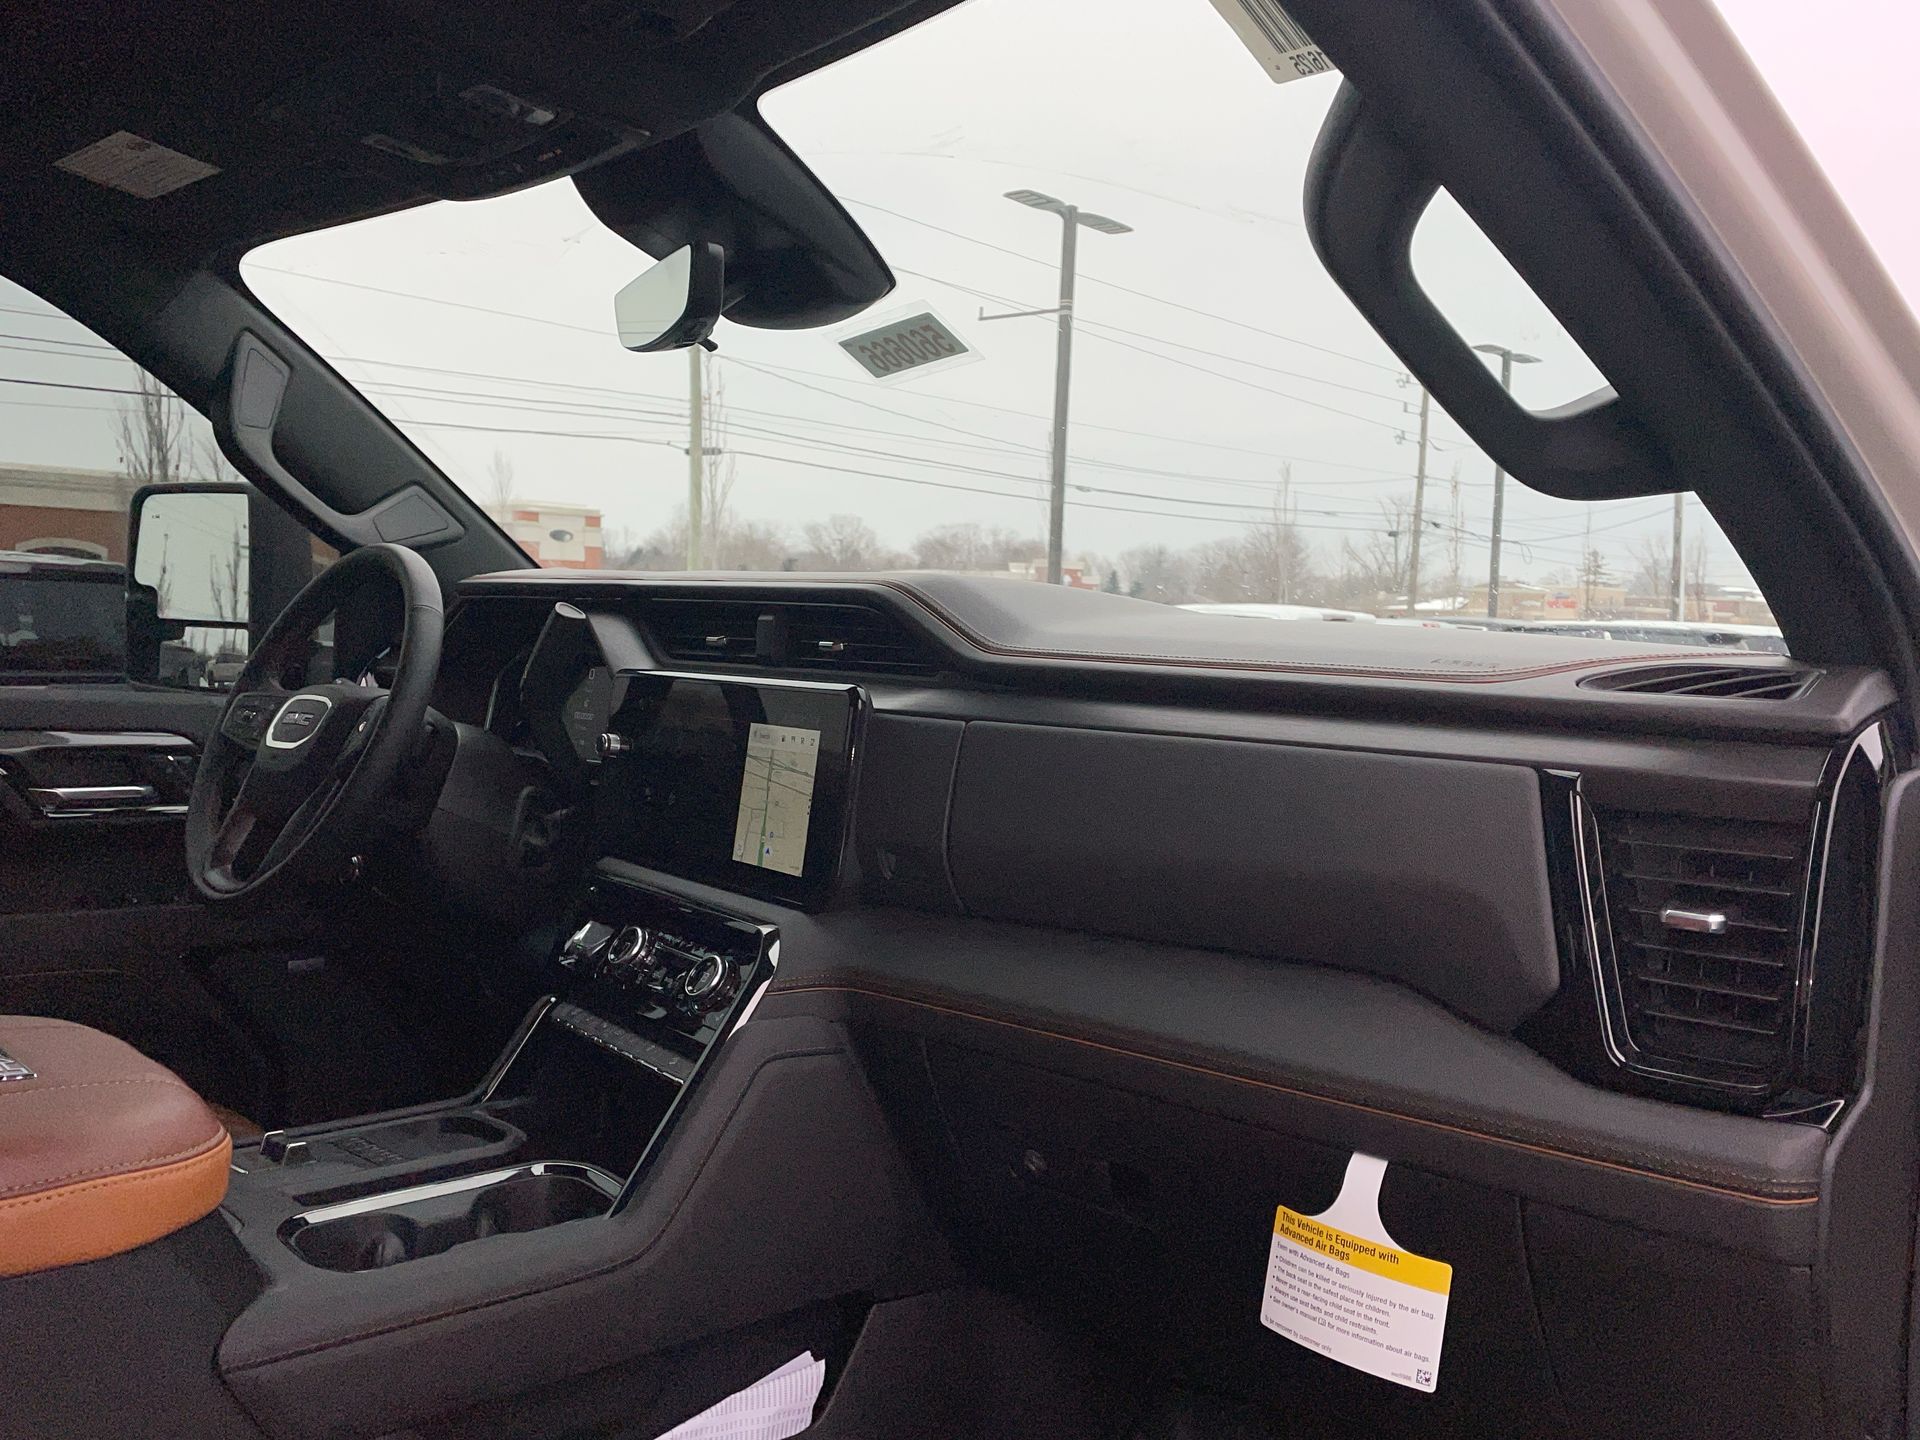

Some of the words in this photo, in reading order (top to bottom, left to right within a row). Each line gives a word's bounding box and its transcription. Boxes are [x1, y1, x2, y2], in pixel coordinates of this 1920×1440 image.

[1280, 1224, 1314, 1246] Advanced
[1316, 1240, 1326, 1252] Air
[1329, 1245, 1350, 1261] Bags
[1282, 1212, 1296, 1226] This
[1297, 1218, 1324, 1238] Vehicle
[1326, 1231, 1333, 1242] is
[1336, 1235, 1376, 1257] Equipped
[1378, 1252, 1400, 1265] with
[1300, 1253, 1325, 1269] Advanced
[1326, 1264, 1334, 1272] Air
[1336, 1268, 1350, 1279] Bags
[1316, 1274, 1330, 1284] killed
[1339, 1283, 1364, 1298] seriously
[1366, 1292, 1388, 1305] injured
[1389, 1300, 1397, 1309] by
[1399, 1303, 1409, 1312] the
[1411, 1307, 1419, 1315] air
[1323, 1288, 1339, 1298] safest
[1340, 1295, 1355, 1305] place
[1356, 1300, 1364, 1308] for
[1364, 1314, 1373, 1322] the
[1352, 1332, 1384, 1348] information
[1386, 1345, 1403, 1354] about
